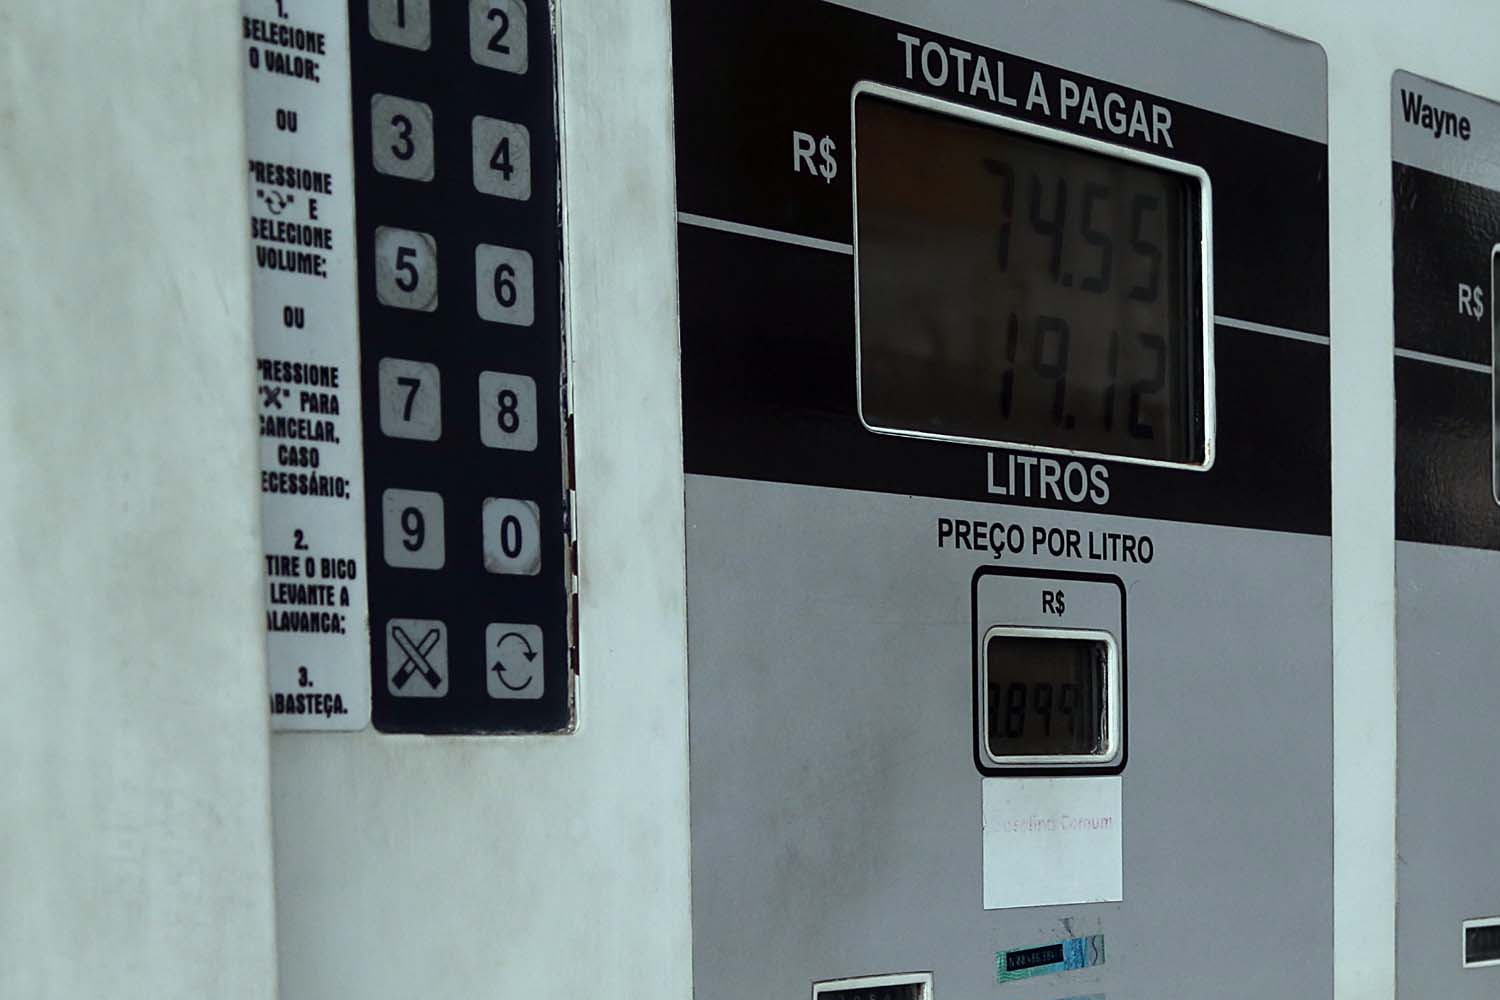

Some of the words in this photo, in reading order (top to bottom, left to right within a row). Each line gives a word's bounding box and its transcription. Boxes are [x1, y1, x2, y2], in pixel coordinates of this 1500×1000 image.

[487, 8, 510, 55] 2
[249, 47, 259, 69] O
[897, 32, 1018, 107] TOTAL
[1024, 71, 1052, 116] A
[1060, 80, 1174, 148] PAGAR
[276, 109, 298, 132] OU
[1401, 88, 1471, 141] Wayne
[391, 114, 415, 160] 3
[489, 137, 514, 181] 4
[792, 130, 837, 183] R$
[308, 199, 318, 220] E
[983, 158, 1164, 303] 74.55
[395, 246, 419, 293] 5
[493, 263, 517, 308] 6
[283, 305, 305, 329] OU
[1458, 283, 1484, 320] R$
[1000, 312, 1167, 441] 19.12
[299, 390, 340, 416] PARA
[397, 377, 421, 422] 7
[497, 390, 519, 434] 8
[277, 446, 320, 469] CASO
[986, 452, 1110, 505] LITROS
[294, 529, 309, 550] 2.
[401, 506, 425, 552] 9
[501, 515, 522, 559] 0
[938, 518, 1025, 559] PREÇO
[1032, 526, 1082, 560] POR
[1088, 531, 1154, 564] LITRO
[305, 557, 316, 578] O
[321, 558, 356, 581] BICO
[270, 583, 336, 607] LEVANTE
[340, 588, 350, 607] A
[1042, 590, 1066, 617] R$
[298, 666, 313, 687] 3.
